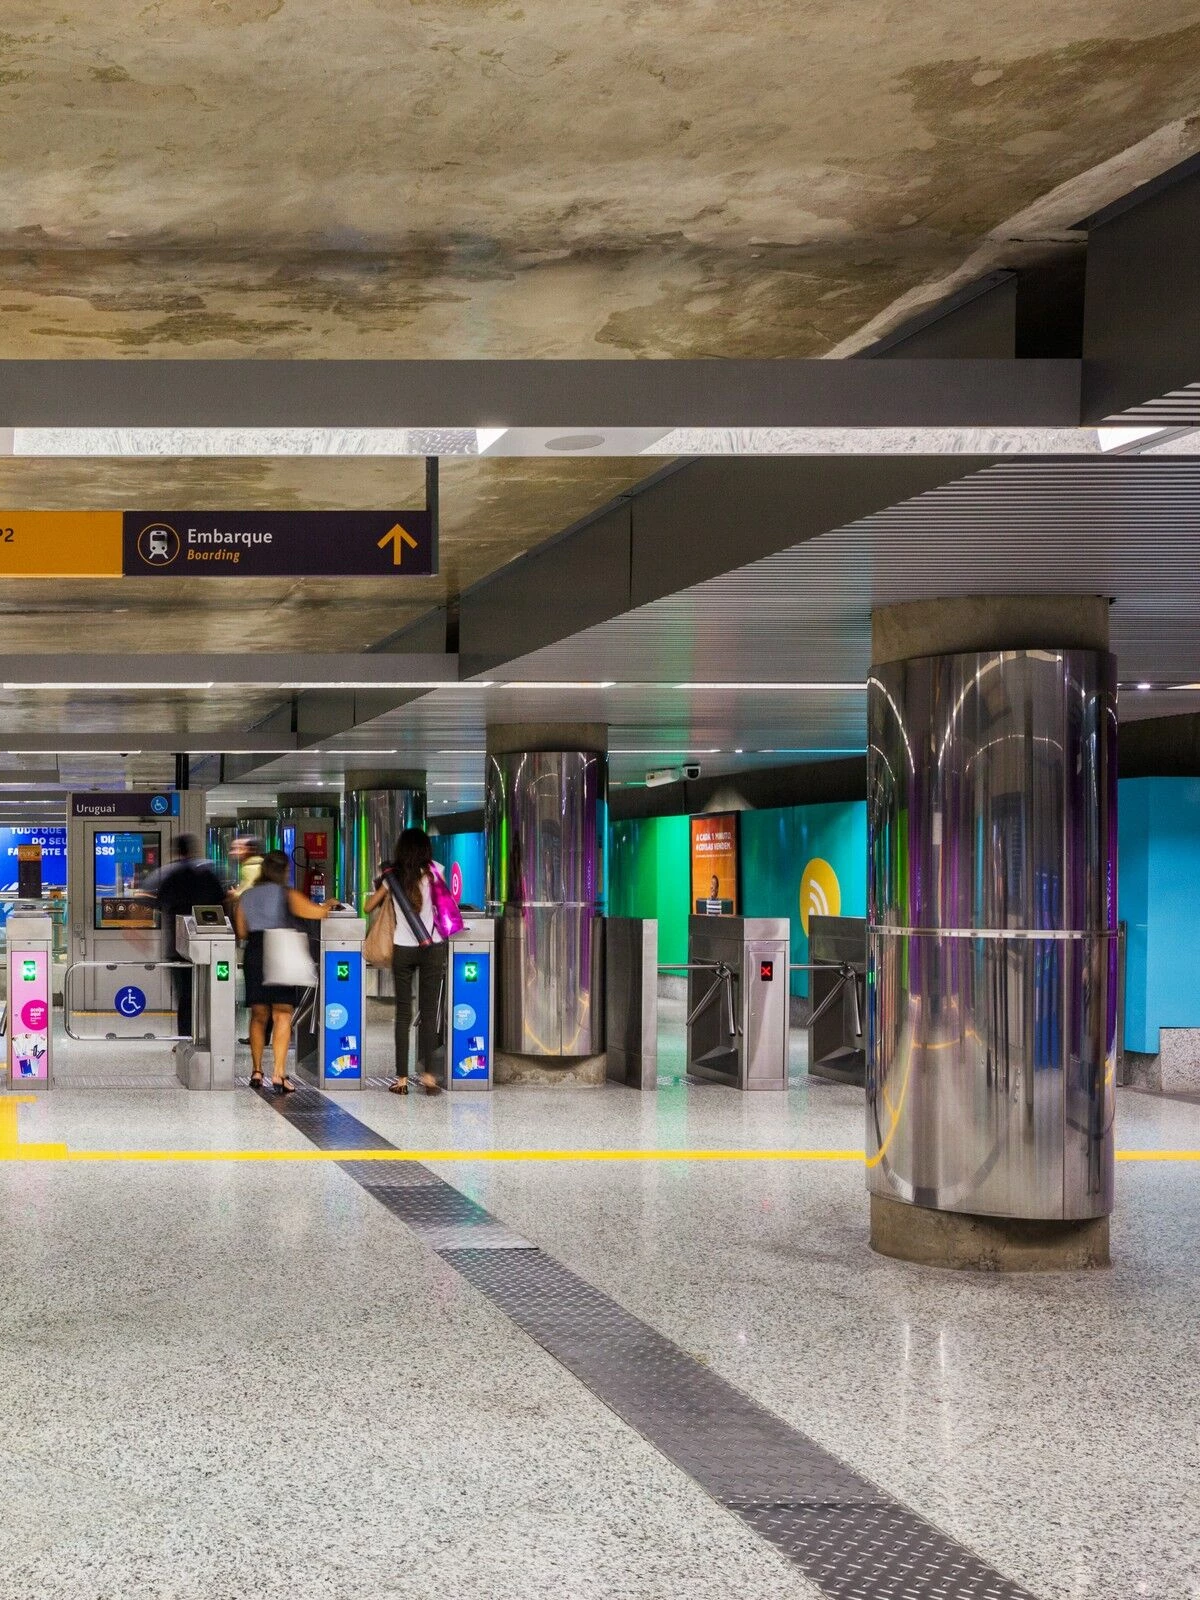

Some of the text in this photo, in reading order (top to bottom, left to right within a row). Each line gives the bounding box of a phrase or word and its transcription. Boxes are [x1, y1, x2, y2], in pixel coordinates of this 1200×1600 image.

[188, 529, 273, 547] Embarque
[188, 549, 240, 562] Boarding
[76, 803, 116, 815] Uruguai
[11, 826, 62, 835] TUDO QUE
[31, 837, 46, 845] DO
